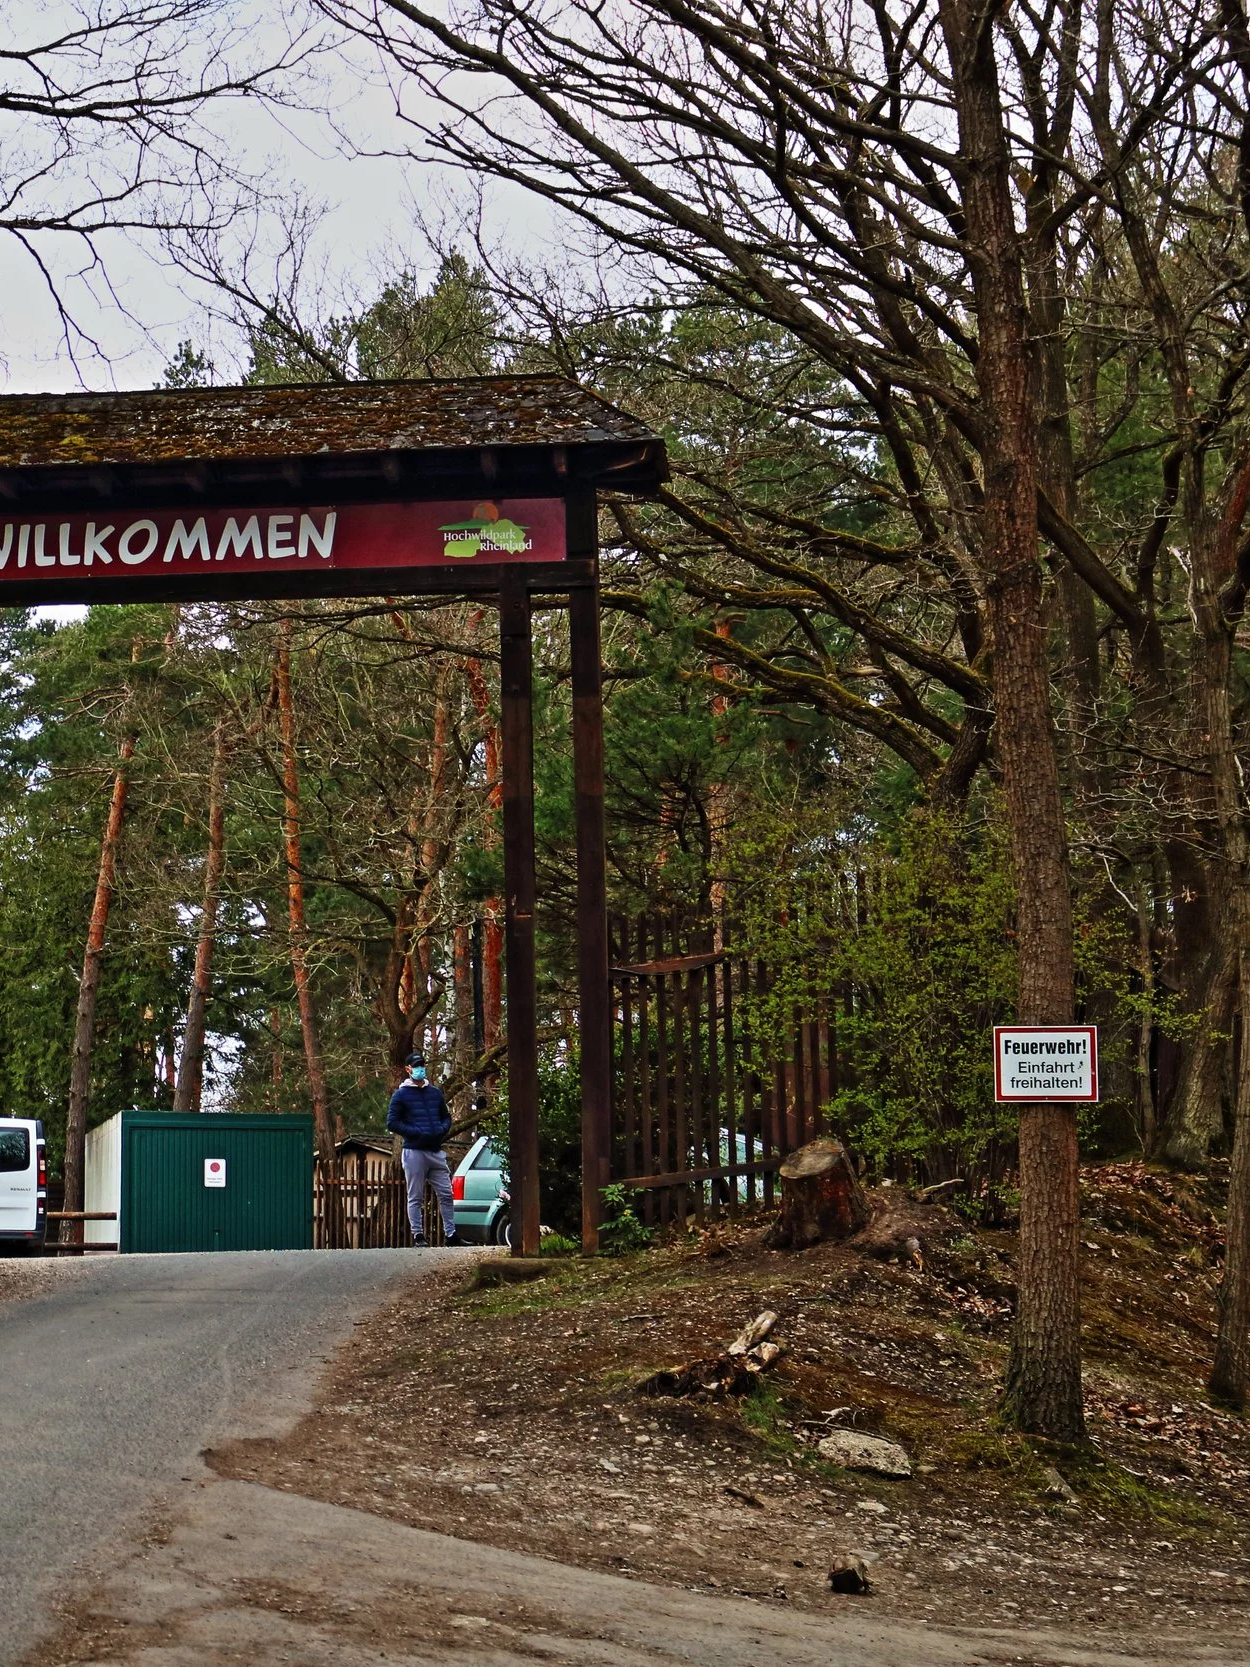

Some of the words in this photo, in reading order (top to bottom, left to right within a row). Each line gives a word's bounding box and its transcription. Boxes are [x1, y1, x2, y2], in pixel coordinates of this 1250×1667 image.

[443, 528, 517, 542] Hochwildpark
[480, 539, 532, 552] Rheinland
[1004, 1039, 1087, 1055] Feuerwehr!
[1018, 1061, 1075, 1074] Einfahrt
[1010, 1076, 1083, 1089] freihalten!
